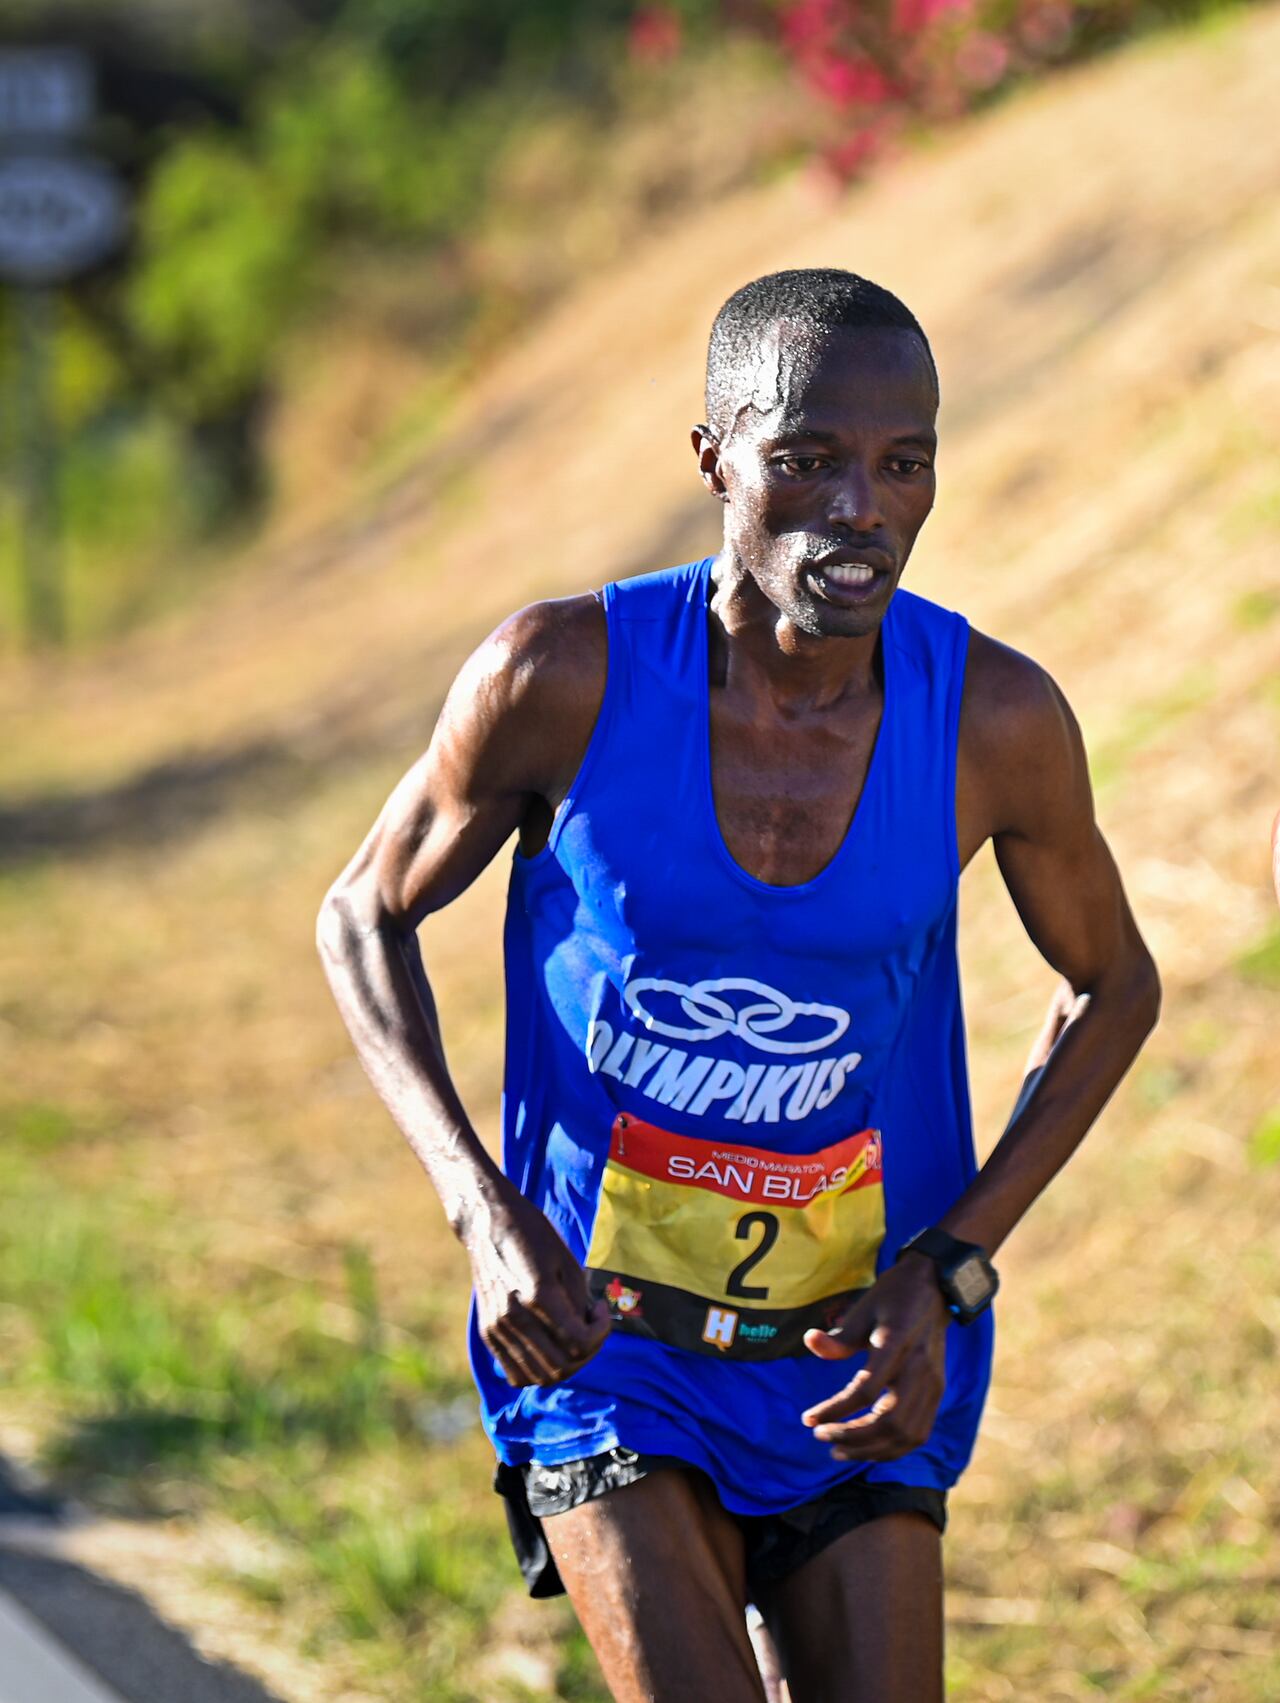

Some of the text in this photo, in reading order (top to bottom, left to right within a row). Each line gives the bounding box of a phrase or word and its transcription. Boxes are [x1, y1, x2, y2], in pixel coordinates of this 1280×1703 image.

[586, 1020, 862, 1124] OLYMPIKUS
[668, 1155, 754, 1194] SAN
[762, 1167, 848, 1200] BLAS
[726, 1211, 779, 1300] 2
